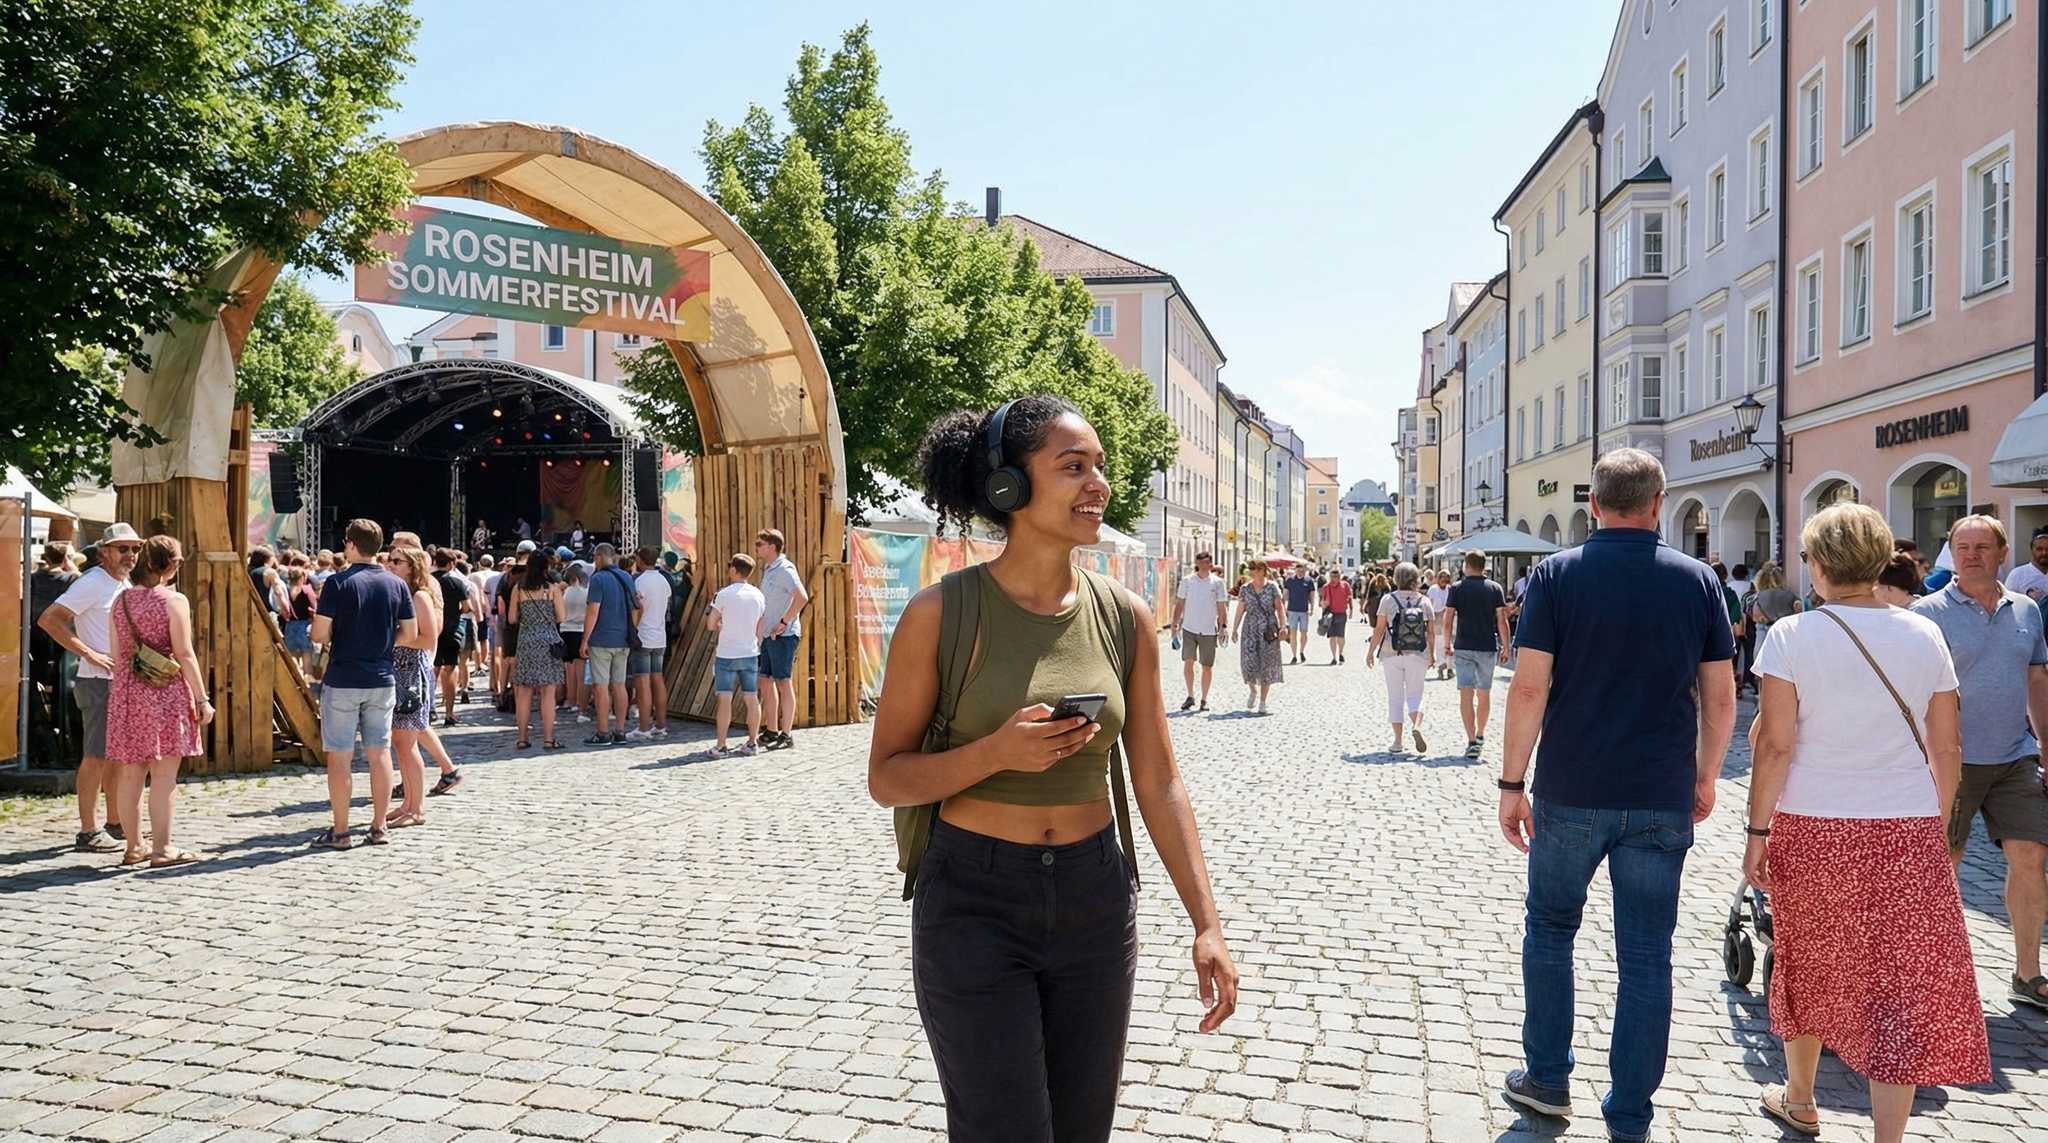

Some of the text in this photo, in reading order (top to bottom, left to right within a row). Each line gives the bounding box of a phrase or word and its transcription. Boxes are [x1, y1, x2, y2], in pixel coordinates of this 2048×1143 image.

[424, 223, 653, 288] ROSENHEIM
[387, 262, 686, 325] SOMMERFESTIVAL
[1689, 426, 1746, 462] Rosenheim
[1875, 405, 1969, 449] ROSENHEIM
